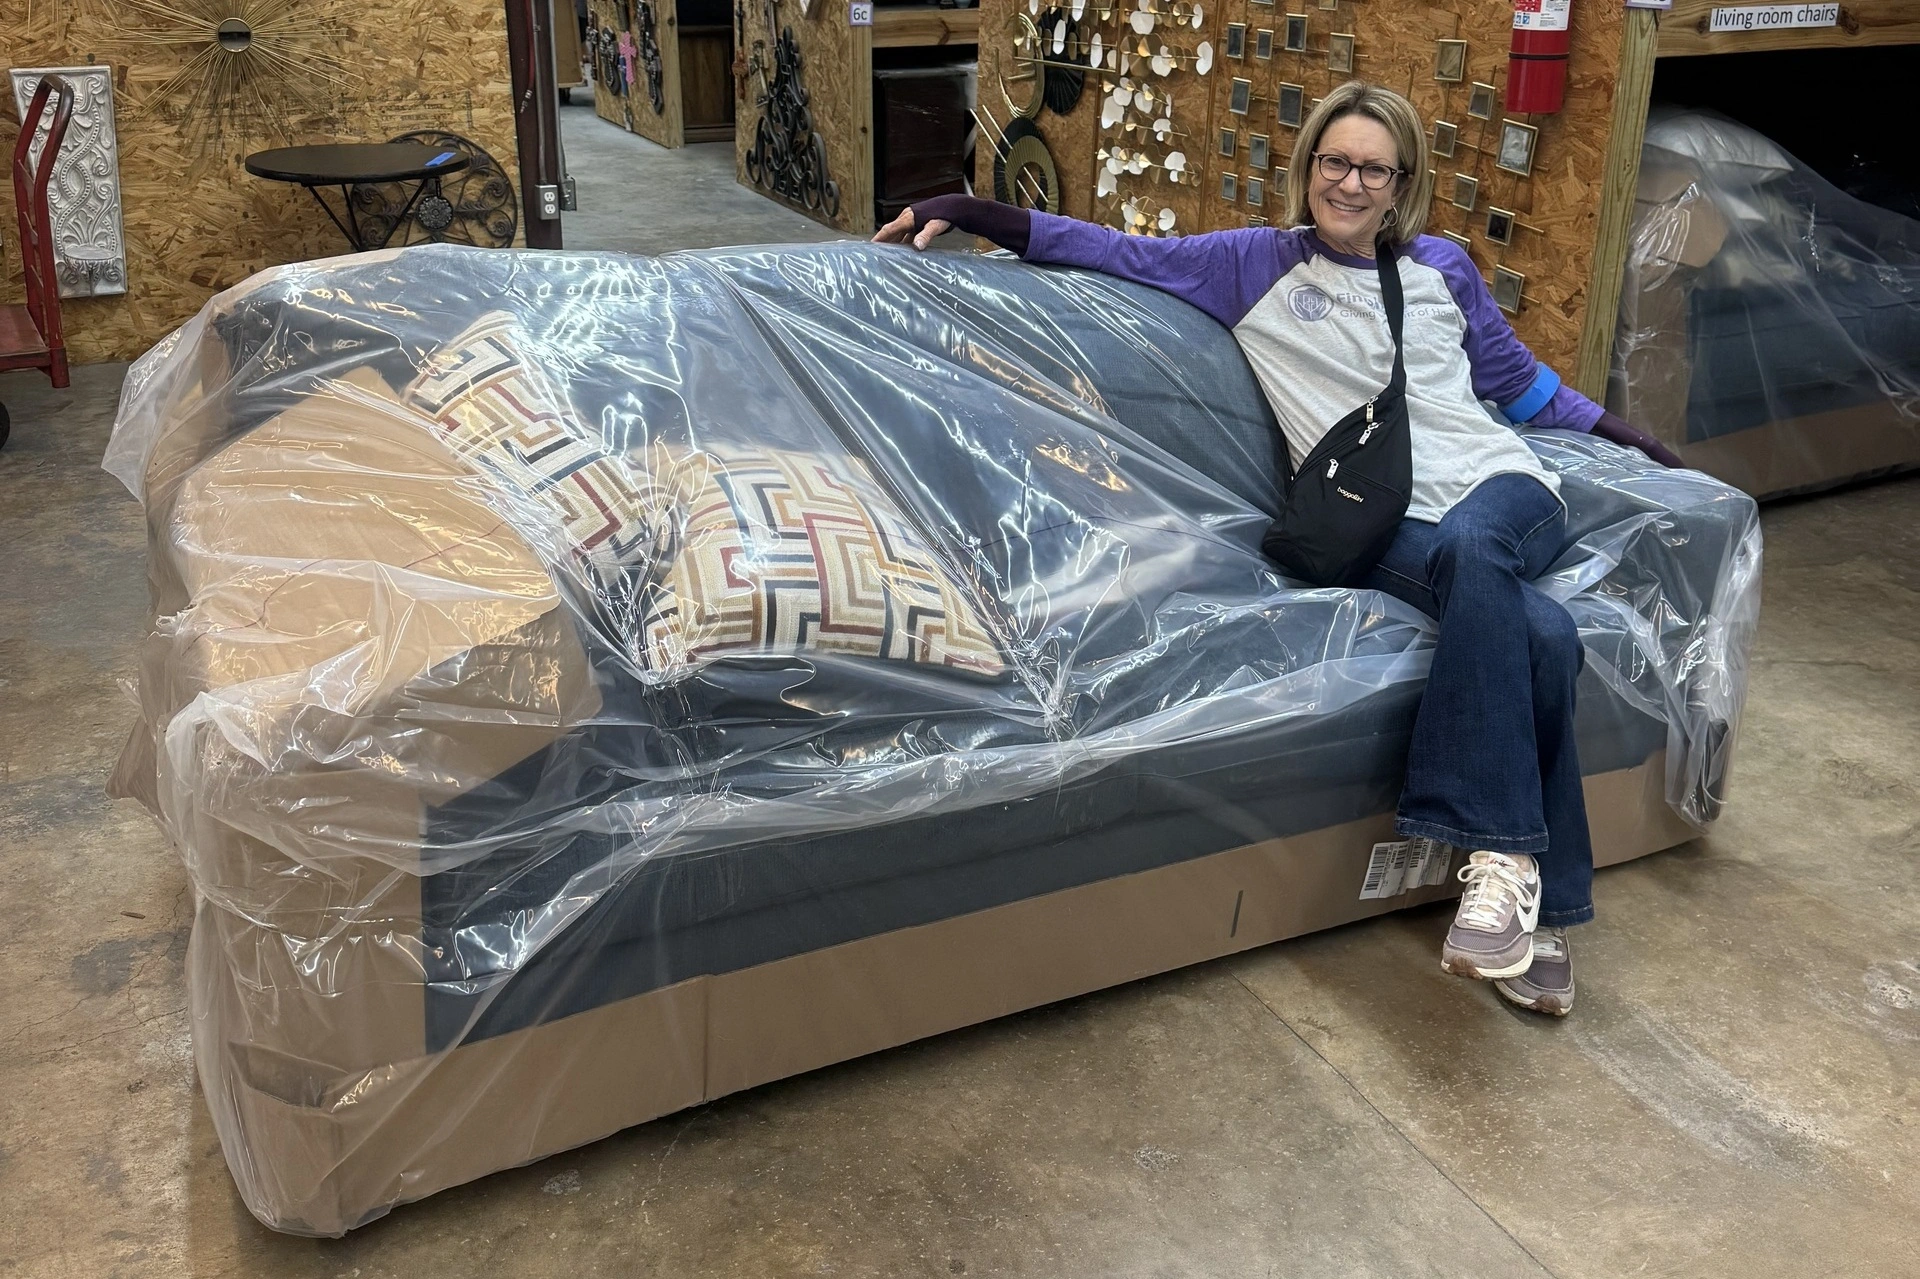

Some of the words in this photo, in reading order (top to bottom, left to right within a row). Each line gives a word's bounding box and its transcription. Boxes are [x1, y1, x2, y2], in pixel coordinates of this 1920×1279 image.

[853, 7, 868, 21] 6c
[1714, 8, 1754, 29] living
[1756, 10, 1793, 25] room
[1797, 5, 1837, 23] chairs
[1340, 309, 1376, 321] Giving
[1417, 307, 1430, 317] of
